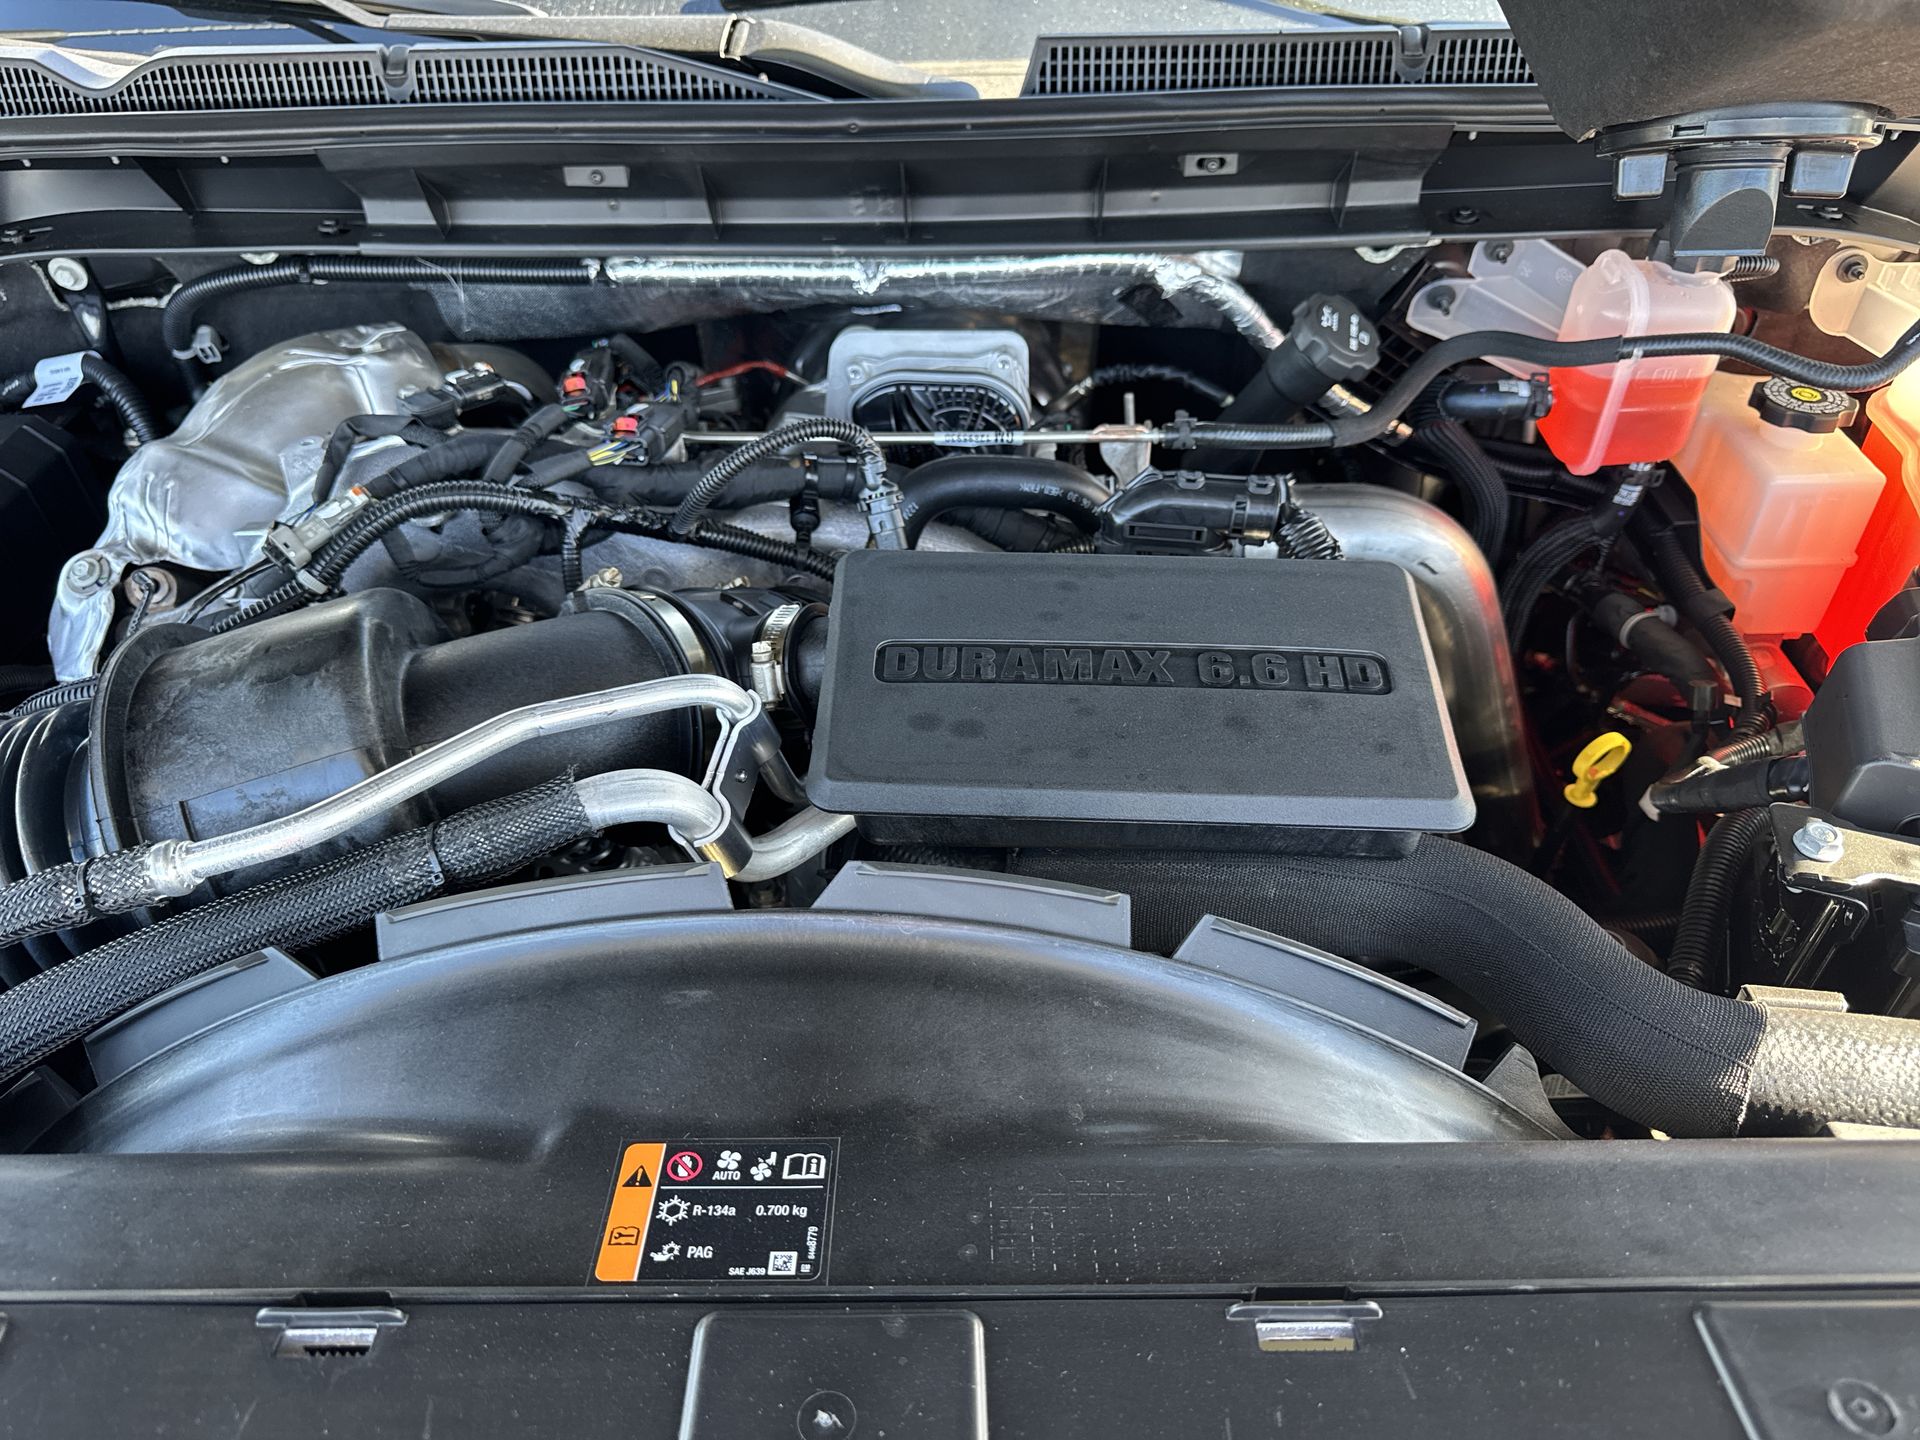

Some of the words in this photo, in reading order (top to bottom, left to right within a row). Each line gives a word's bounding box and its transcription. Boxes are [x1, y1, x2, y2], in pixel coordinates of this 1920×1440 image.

[882, 645, 1175, 683] DURAMAX
[1196, 651, 1289, 688] 6.6
[1303, 655, 1385, 691] HD
[712, 1170, 741, 1181] AUTO
[692, 1204, 736, 1217] R-134a
[755, 1204, 789, 1217] 0.700
[792, 1204, 808, 1219] kg
[686, 1245, 714, 1259] PAG
[728, 1266, 744, 1276] SAE
[745, 1267, 766, 1276] J639
